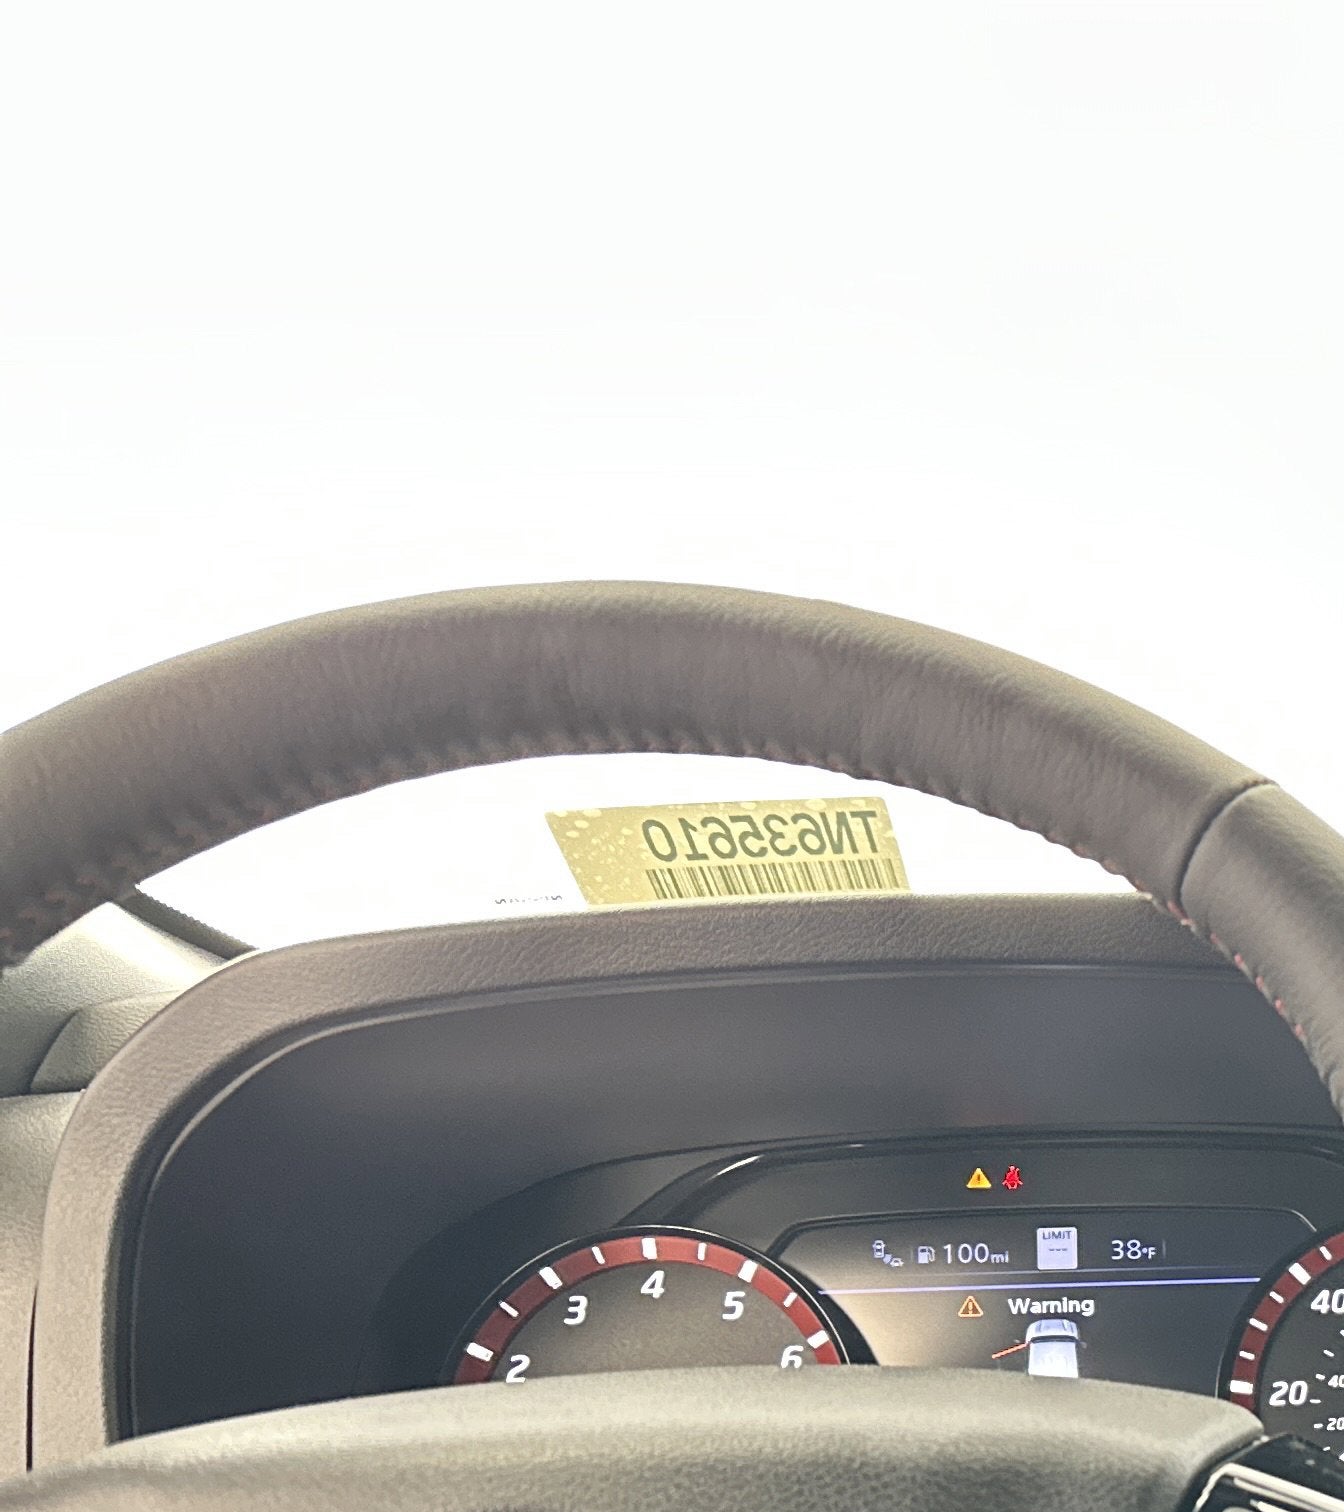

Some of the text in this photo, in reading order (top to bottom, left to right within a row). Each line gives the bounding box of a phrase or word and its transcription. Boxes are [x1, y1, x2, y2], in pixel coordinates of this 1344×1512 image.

[1042, 1229, 1072, 1241] LIMIT
[640, 1270, 665, 1298] 4
[564, 1294, 588, 1325] 3
[722, 1291, 745, 1320] 5
[1007, 1296, 1095, 1317] Warning
[506, 1355, 530, 1383] 2
[781, 1345, 804, 1368] 6
[1269, 1381, 1308, 1406] 20
